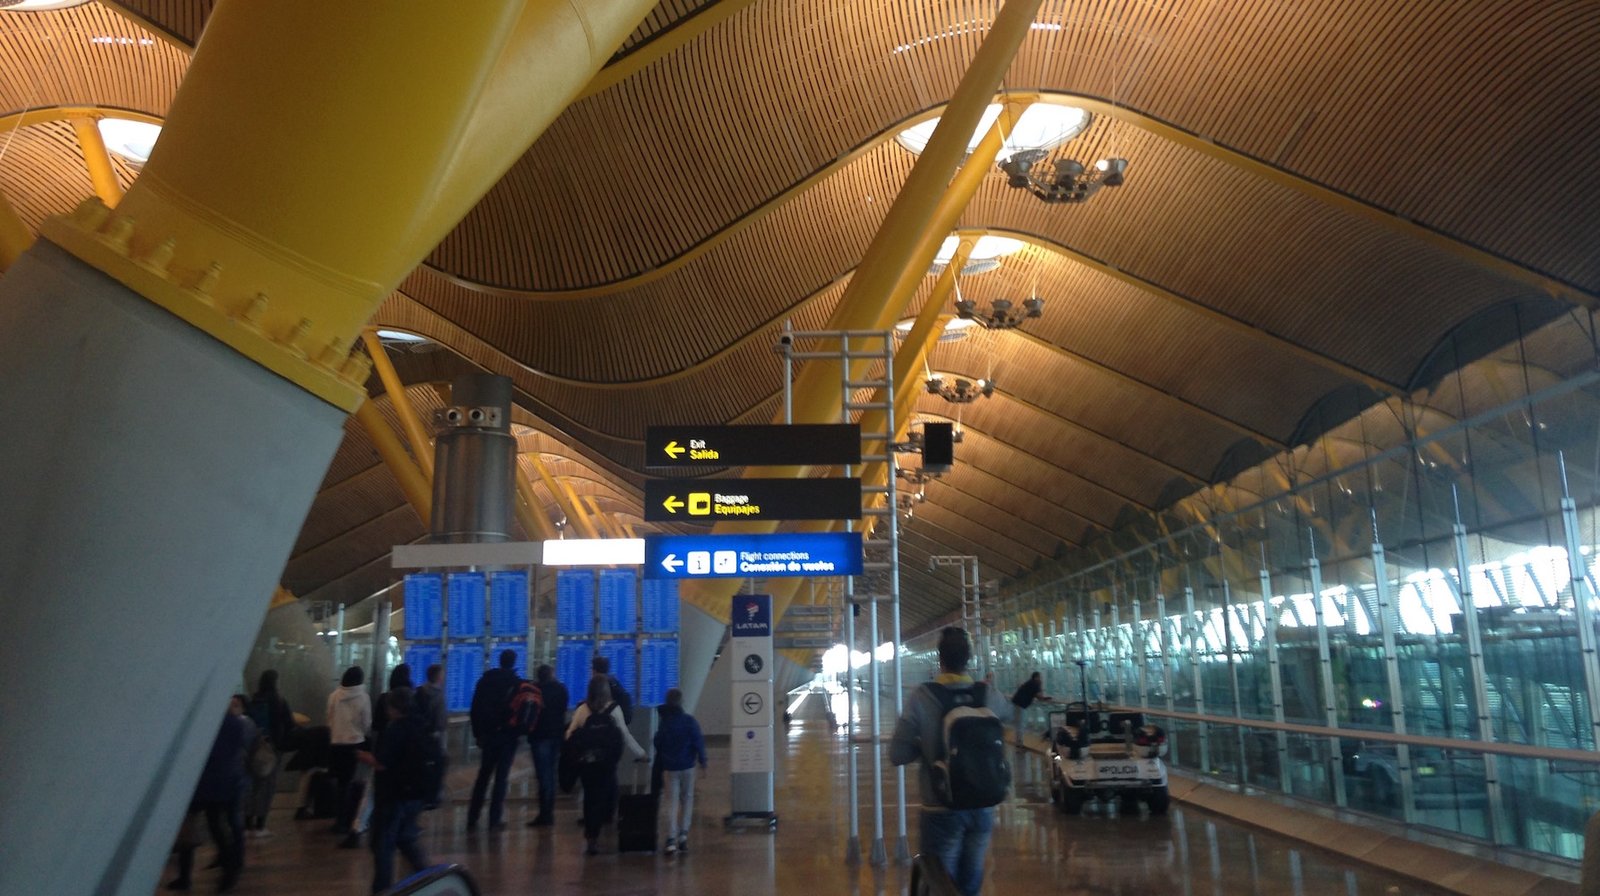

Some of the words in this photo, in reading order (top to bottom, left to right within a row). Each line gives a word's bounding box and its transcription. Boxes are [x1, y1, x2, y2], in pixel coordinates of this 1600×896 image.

[690, 439, 706, 449] Exit
[690, 449, 719, 459] Salida
[714, 493, 749, 505] Baggage
[714, 504, 760, 516] Equipajes
[740, 551, 762, 562] Flight
[763, 551, 810, 561] connections
[787, 561, 801, 571] de
[802, 560, 835, 571] vuelos
[736, 622, 768, 630] LATAM
